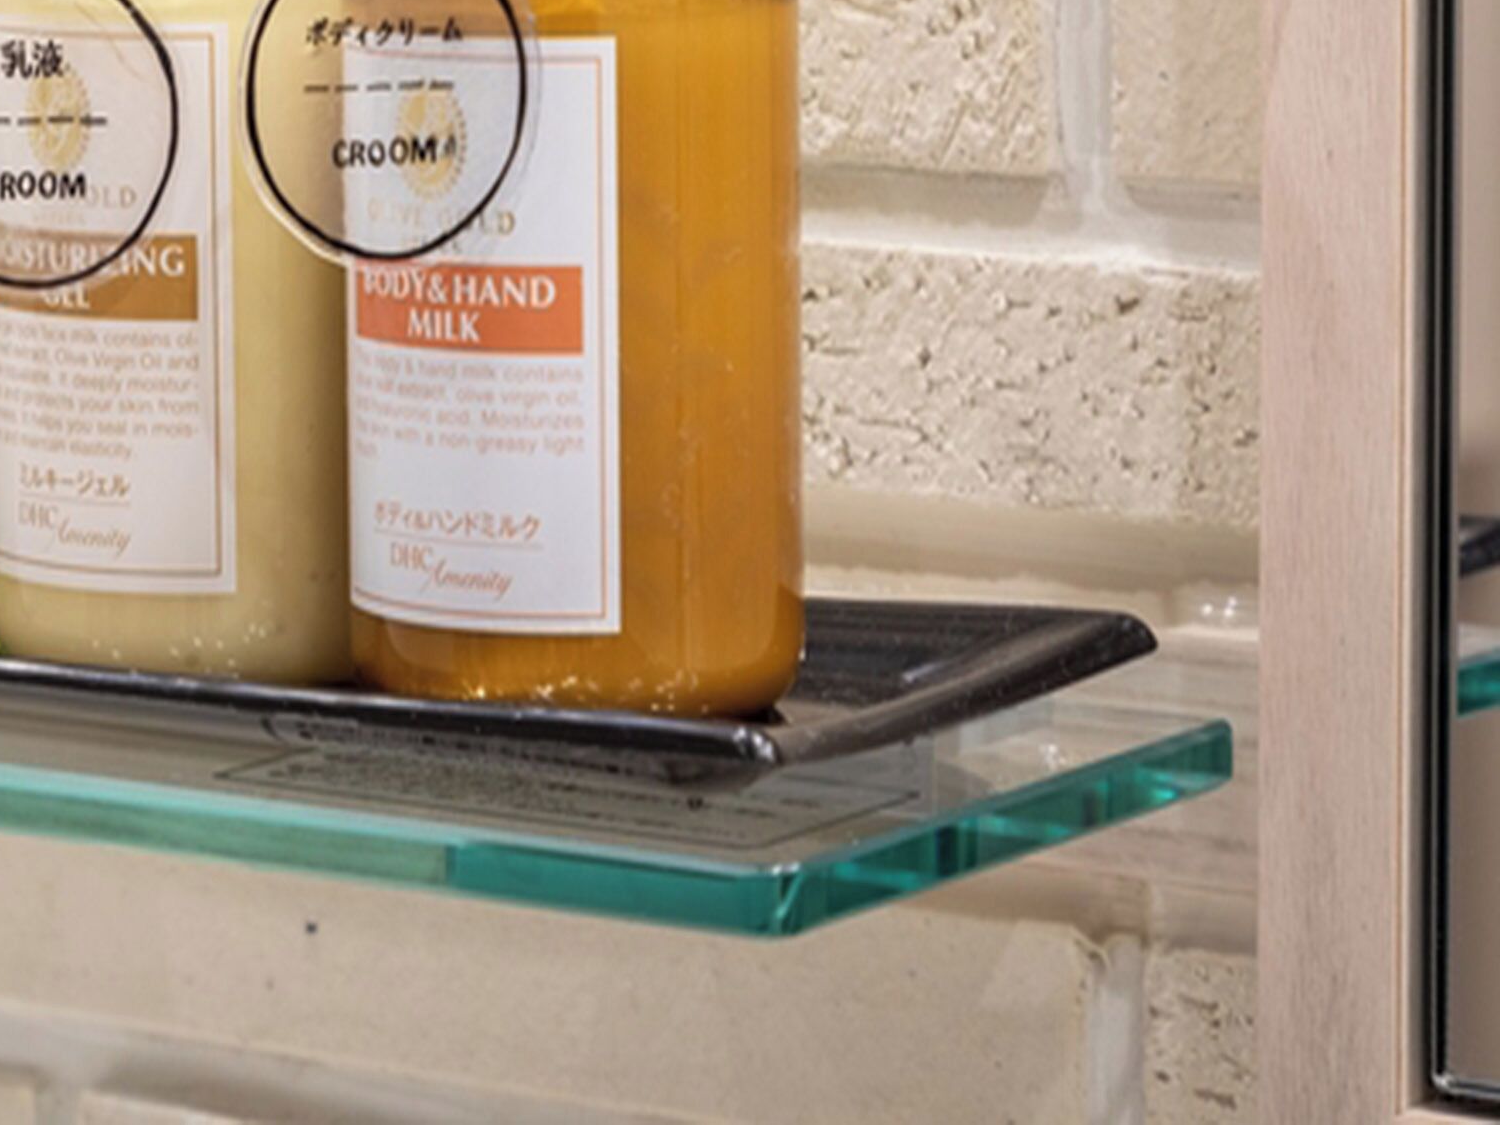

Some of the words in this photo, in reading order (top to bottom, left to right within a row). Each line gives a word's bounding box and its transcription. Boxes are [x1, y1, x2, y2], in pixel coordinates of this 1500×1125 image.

[306, 15, 463, 47] ボディクリーム
[0, 39, 67, 77] 乳液
[332, 135, 438, 169] CROOM
[407, 308, 481, 344] MILK
[18, 501, 59, 530] DHC
[390, 541, 434, 572] DHC
